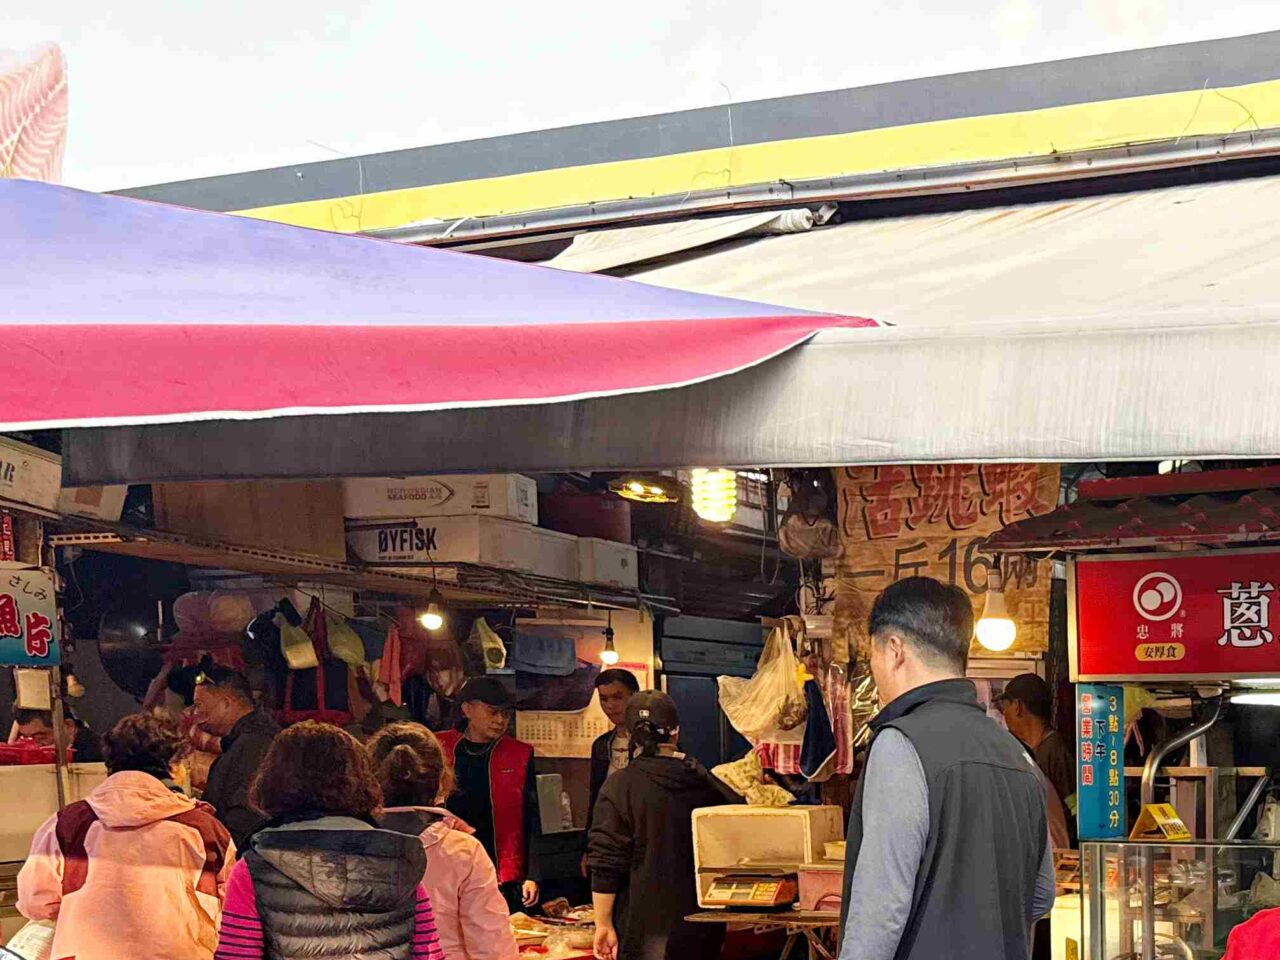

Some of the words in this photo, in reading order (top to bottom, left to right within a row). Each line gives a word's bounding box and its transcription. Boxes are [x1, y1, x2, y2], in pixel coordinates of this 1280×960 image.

[378, 528, 437, 552] ØYFISK
[9, 575, 48, 601] さしみ
[1081, 694, 1094, 786] 營業時間
[1095, 720, 1106, 760] 下午
